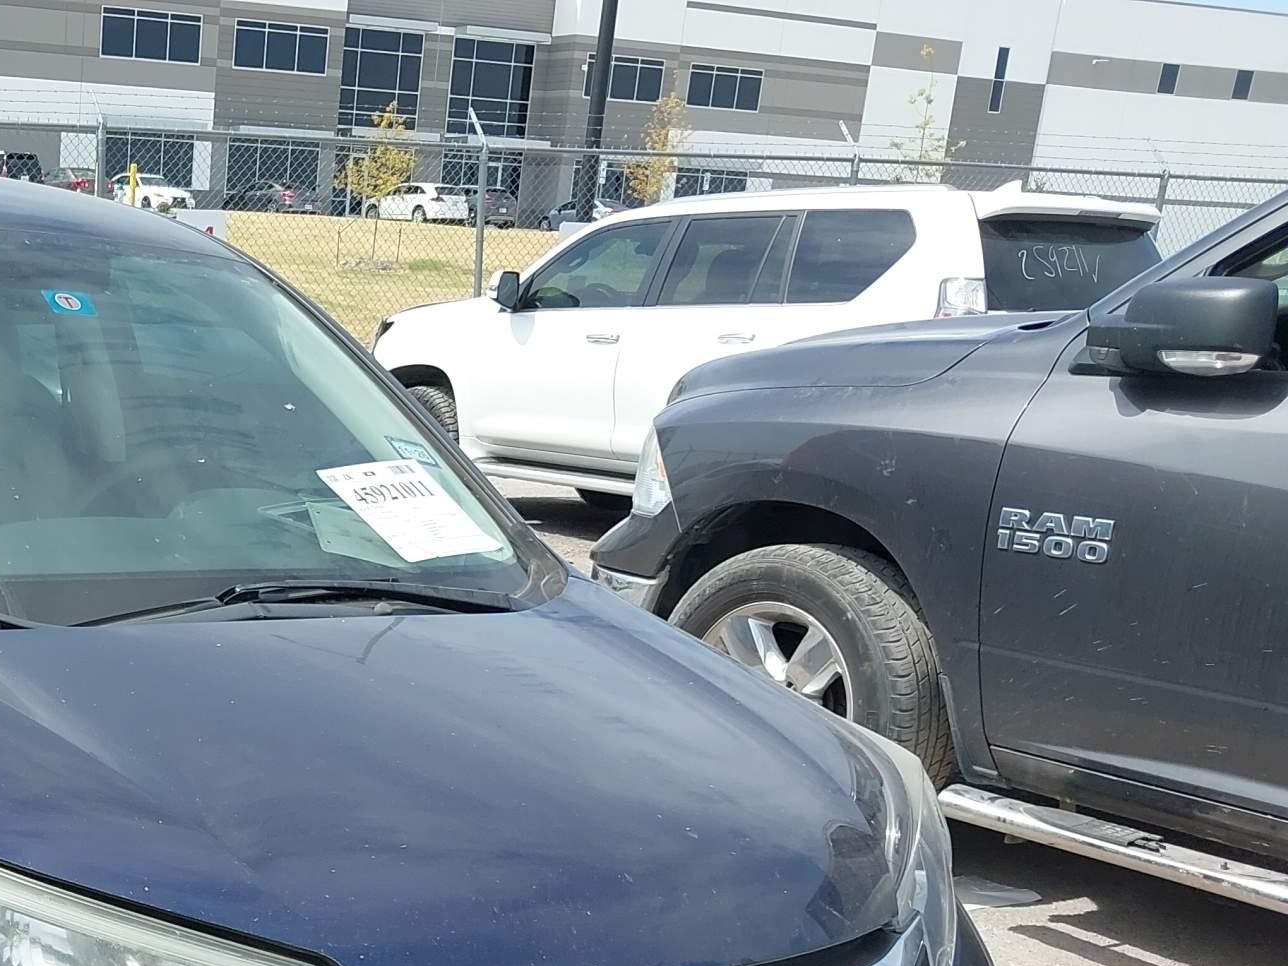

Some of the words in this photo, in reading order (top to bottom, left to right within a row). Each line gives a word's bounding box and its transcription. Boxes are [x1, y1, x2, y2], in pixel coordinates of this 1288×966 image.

[353, 480, 436, 505] 45921011
[999, 506, 1116, 540] RAM
[997, 528, 1109, 564] 1500
